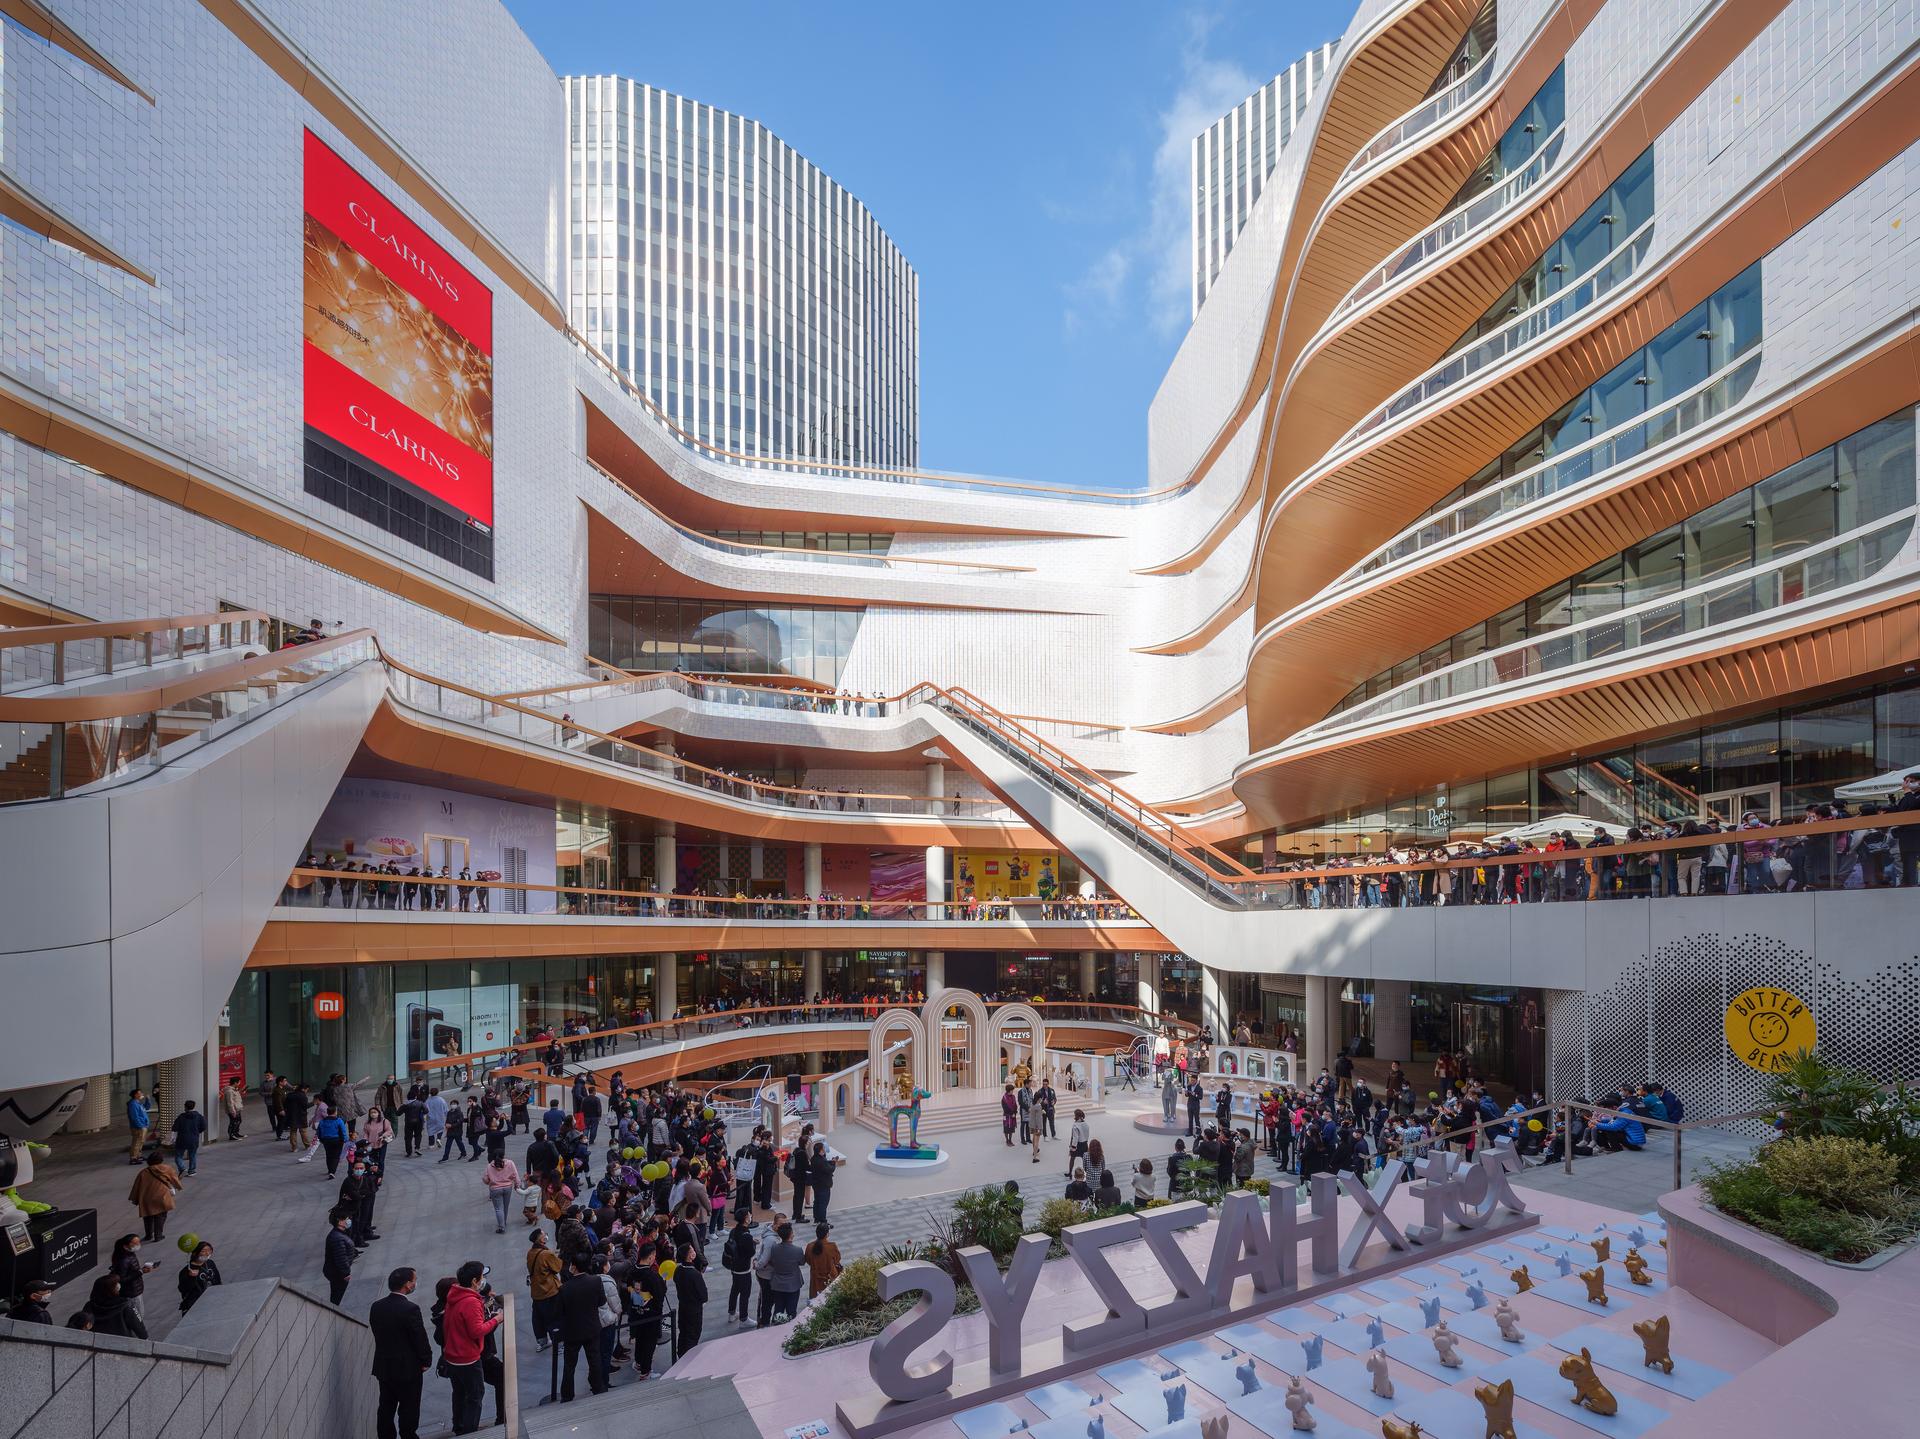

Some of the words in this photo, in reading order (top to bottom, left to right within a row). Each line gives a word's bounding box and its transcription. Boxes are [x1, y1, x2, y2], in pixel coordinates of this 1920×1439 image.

[348, 202, 459, 302] CLARINS
[349, 405, 460, 481] CLARINS
[1173, 954, 1183, 962] &
[1279, 1007, 1296, 1021] HEY
[1734, 991, 1803, 1019] BUTTER
[1003, 1031, 1031, 1039] HAZZYS
[51, 1246, 68, 1261] LAM
[69, 1237, 88, 1252] TOYS
